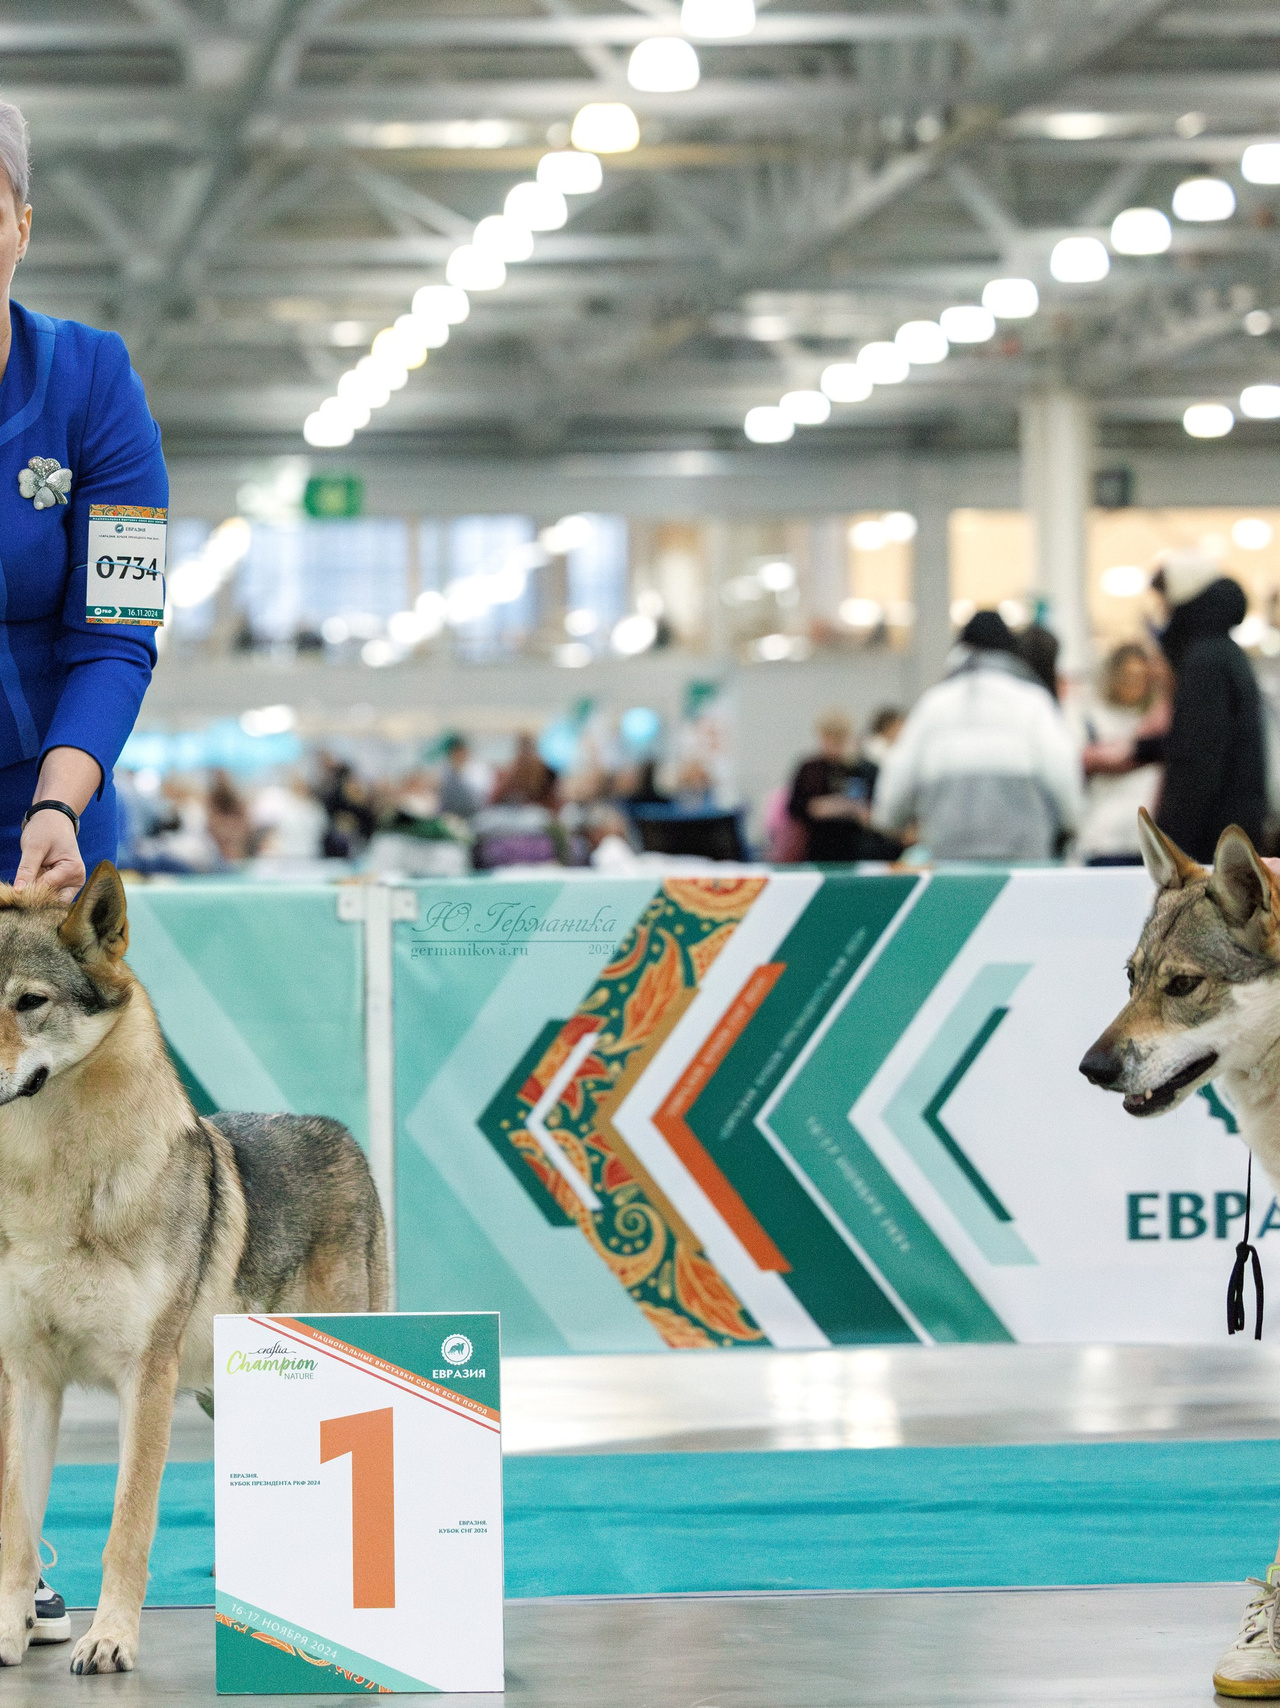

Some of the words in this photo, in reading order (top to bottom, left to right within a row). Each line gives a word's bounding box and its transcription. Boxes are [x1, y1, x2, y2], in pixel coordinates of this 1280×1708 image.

[95, 555, 158, 581] 0734
[127, 608, 159, 618] 16.11.2024
[226, 1350, 318, 1376] Champion
[284, 1372, 314, 1380] NATURE
[312, 1331, 373, 1363] НАЦИОНАЛЬНЫЕ
[374, 1359, 415, 1382] ВЫСТАВКИ
[415, 1377, 441, 1394] СОБАК
[442, 1389, 461, 1403] ВСЕХ
[462, 1399, 488, 1416] ПОРОД
[432, 1368, 486, 1379] ЕВРАЗИЯ
[320, 1406, 395, 1608] 1
[231, 1603, 260, 1622] 16-17
[261, 1617, 309, 1645] НОЯБРЯ
[310, 1640, 338, 1659] 2024
